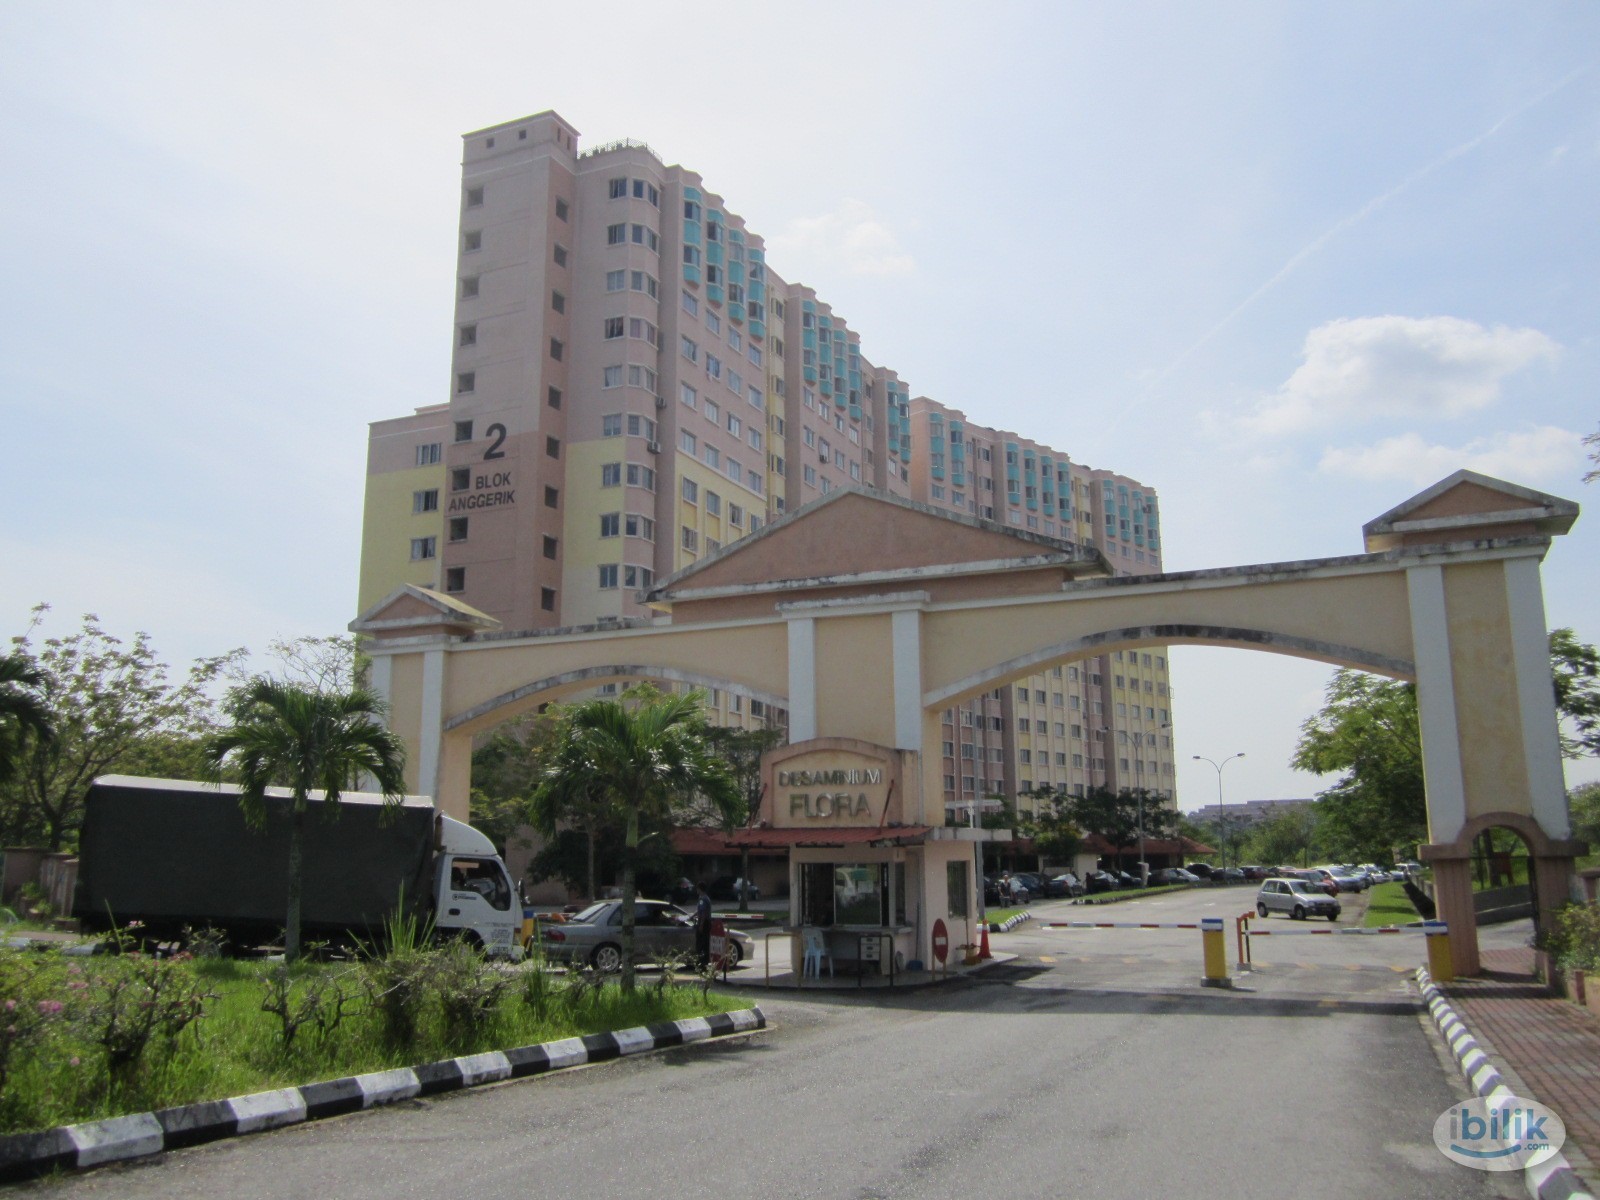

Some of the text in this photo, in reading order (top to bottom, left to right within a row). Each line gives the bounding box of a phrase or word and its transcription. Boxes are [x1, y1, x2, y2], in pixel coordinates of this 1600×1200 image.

[483, 422, 507, 461] 2
[475, 471, 511, 490] BLOK
[448, 489, 515, 512] ANGGERIK
[789, 792, 872, 818] FLORA
